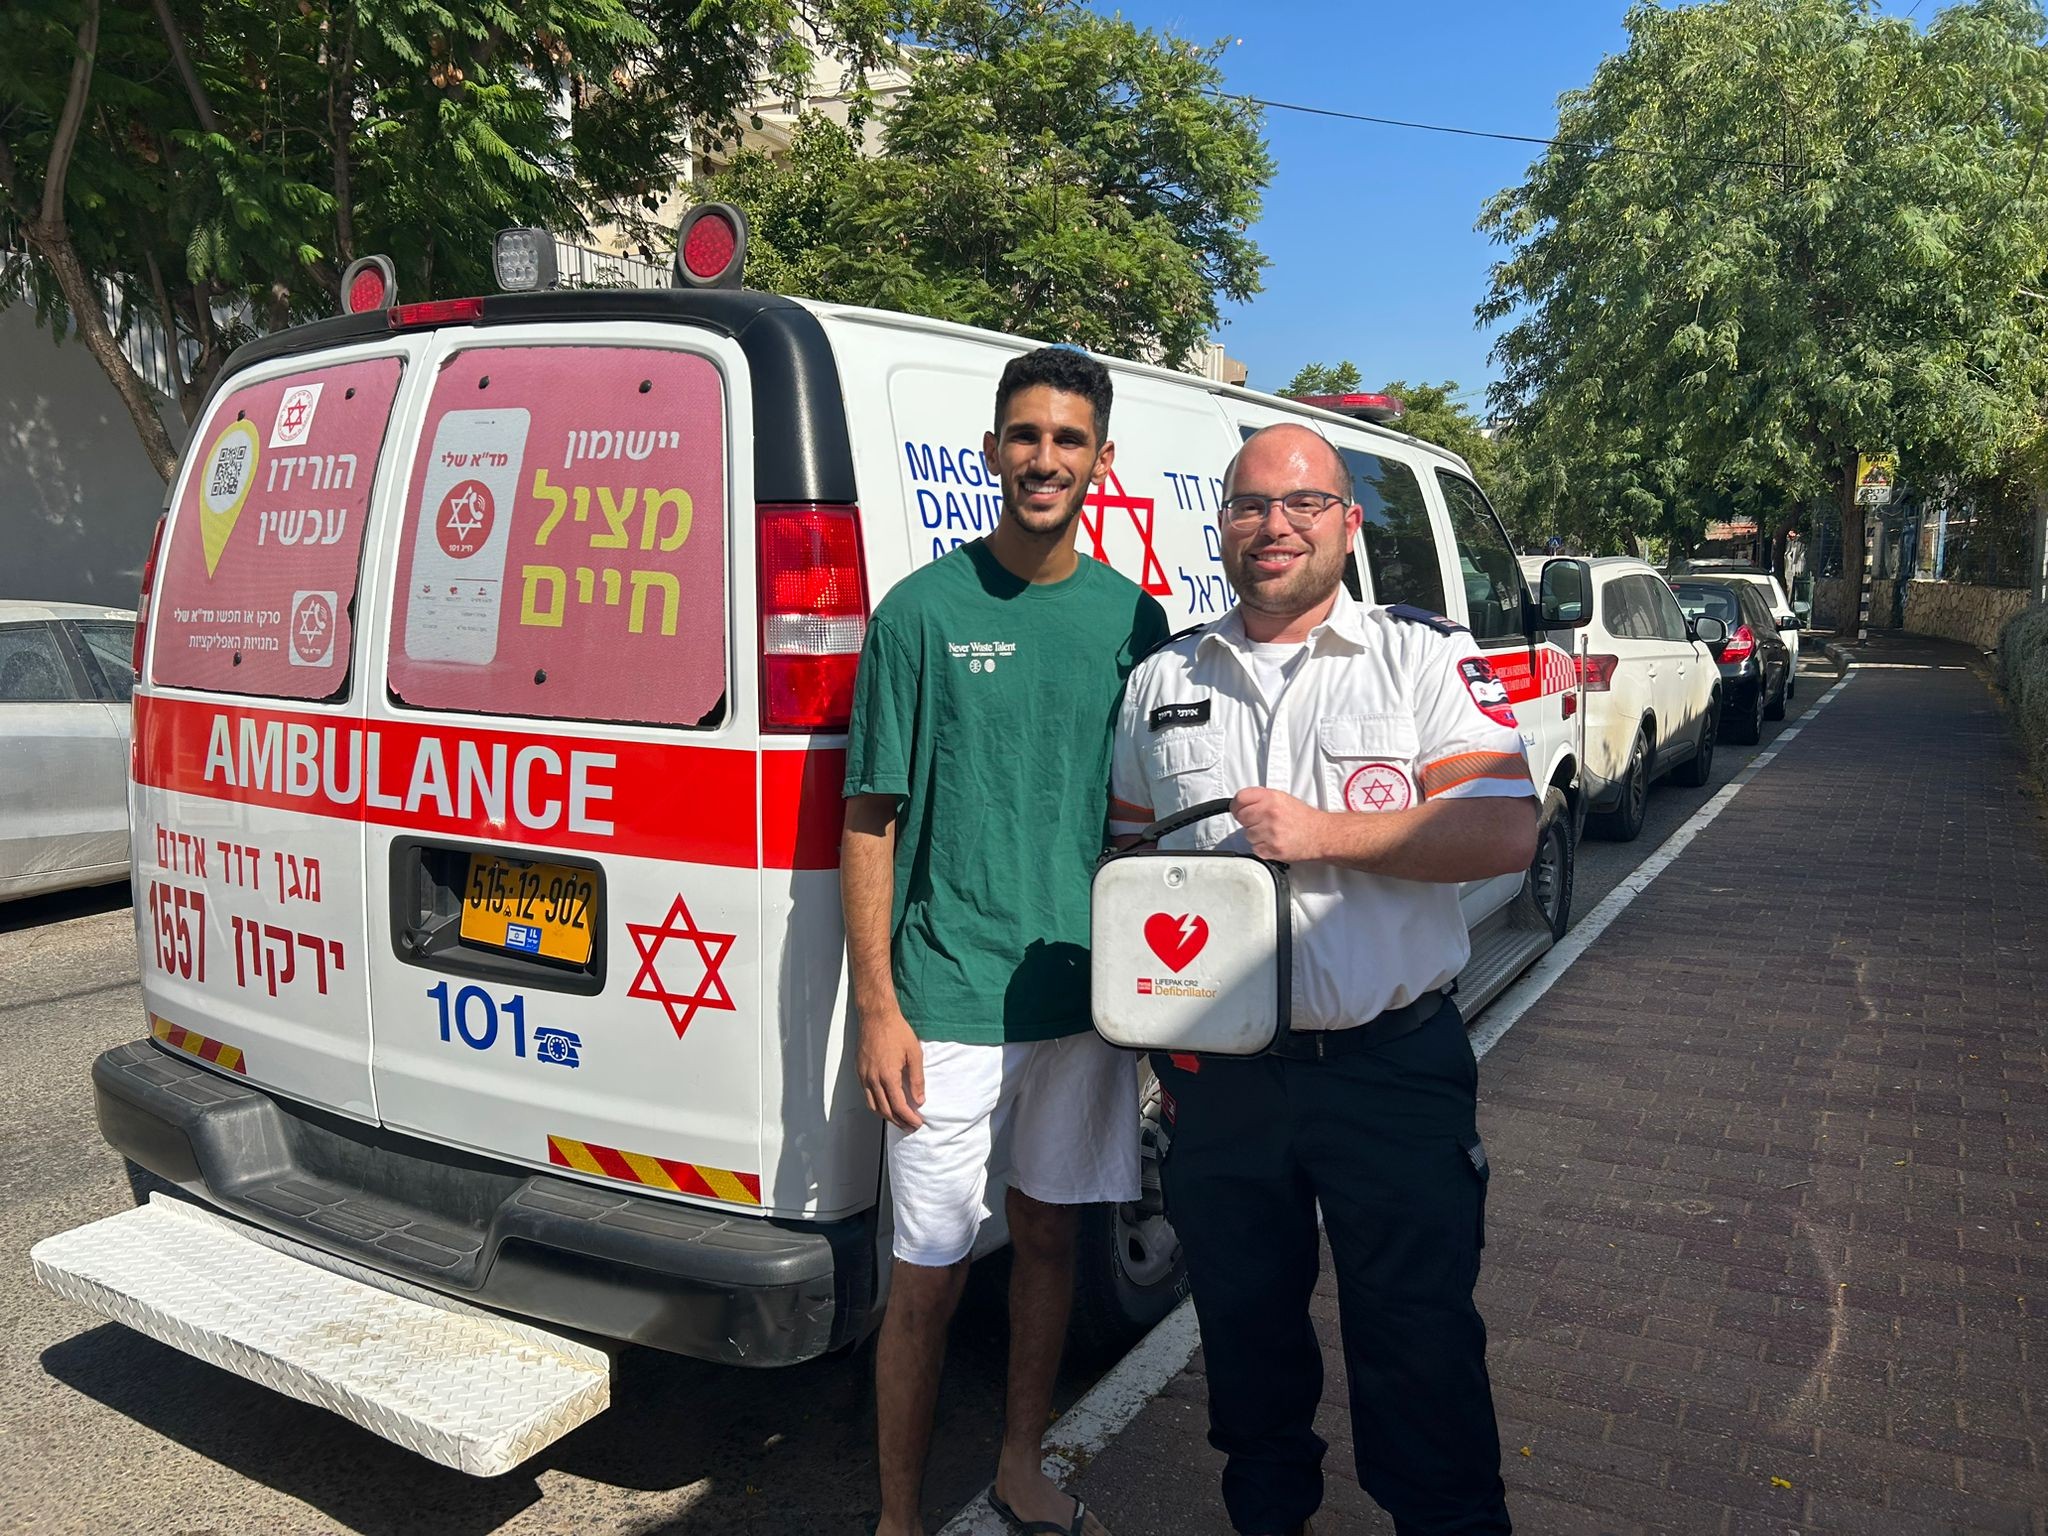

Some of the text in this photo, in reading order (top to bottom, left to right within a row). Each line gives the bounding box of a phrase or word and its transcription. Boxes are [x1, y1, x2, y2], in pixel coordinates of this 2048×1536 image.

[442, 451, 468, 467] שלי
[563, 429, 680, 469] יישומון
[266, 453, 357, 492] הורידו
[258, 508, 347, 546] עכשיו
[531, 468, 693, 552] מציל
[520, 565, 680, 636] חיים
[948, 641, 1016, 652] Never Waste Talent
[204, 714, 617, 837] AMBULANCE
[157, 823, 321, 904] מגן דוד אדום
[150, 880, 345, 998] ירקון 1557
[1155, 978, 1182, 986] LIFEPAK
[1184, 979, 1198, 987] CR2
[1155, 985, 1217, 998] Defibrillator
[426, 980, 526, 1059] 101
